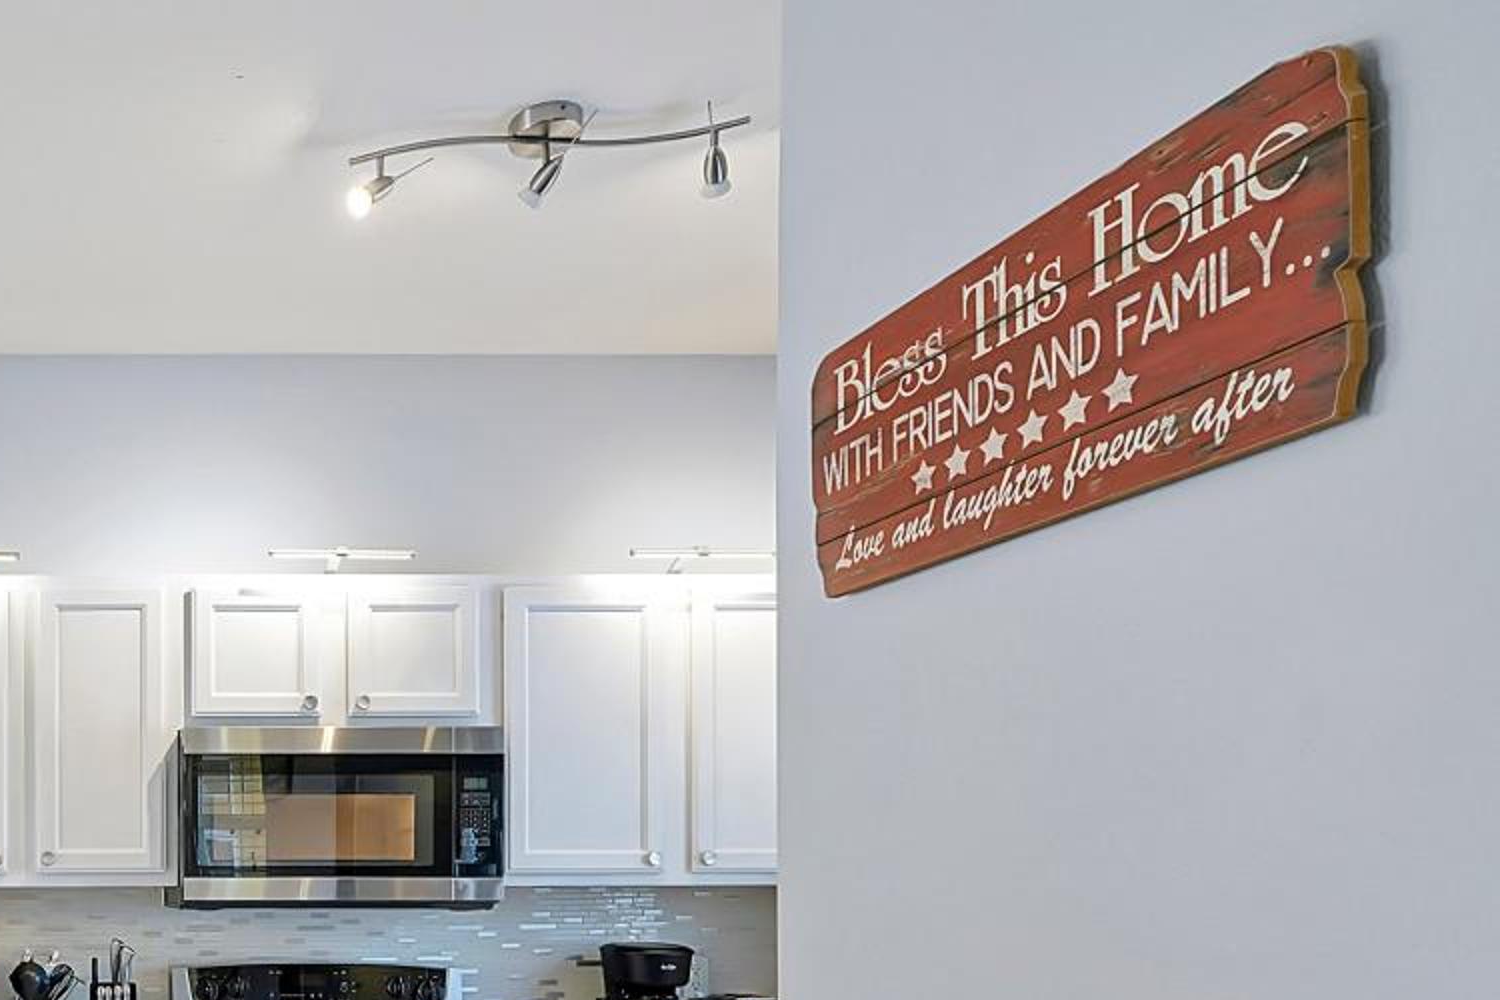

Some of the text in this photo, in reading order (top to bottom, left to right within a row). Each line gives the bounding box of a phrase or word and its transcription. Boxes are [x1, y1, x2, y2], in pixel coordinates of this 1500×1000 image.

[822, 216, 1331, 496] WITH FRIENDS AND FAMILY...
[833, 121, 1309, 435] Bless This Home
[835, 366, 1295, 571] Love and laughter forever after
